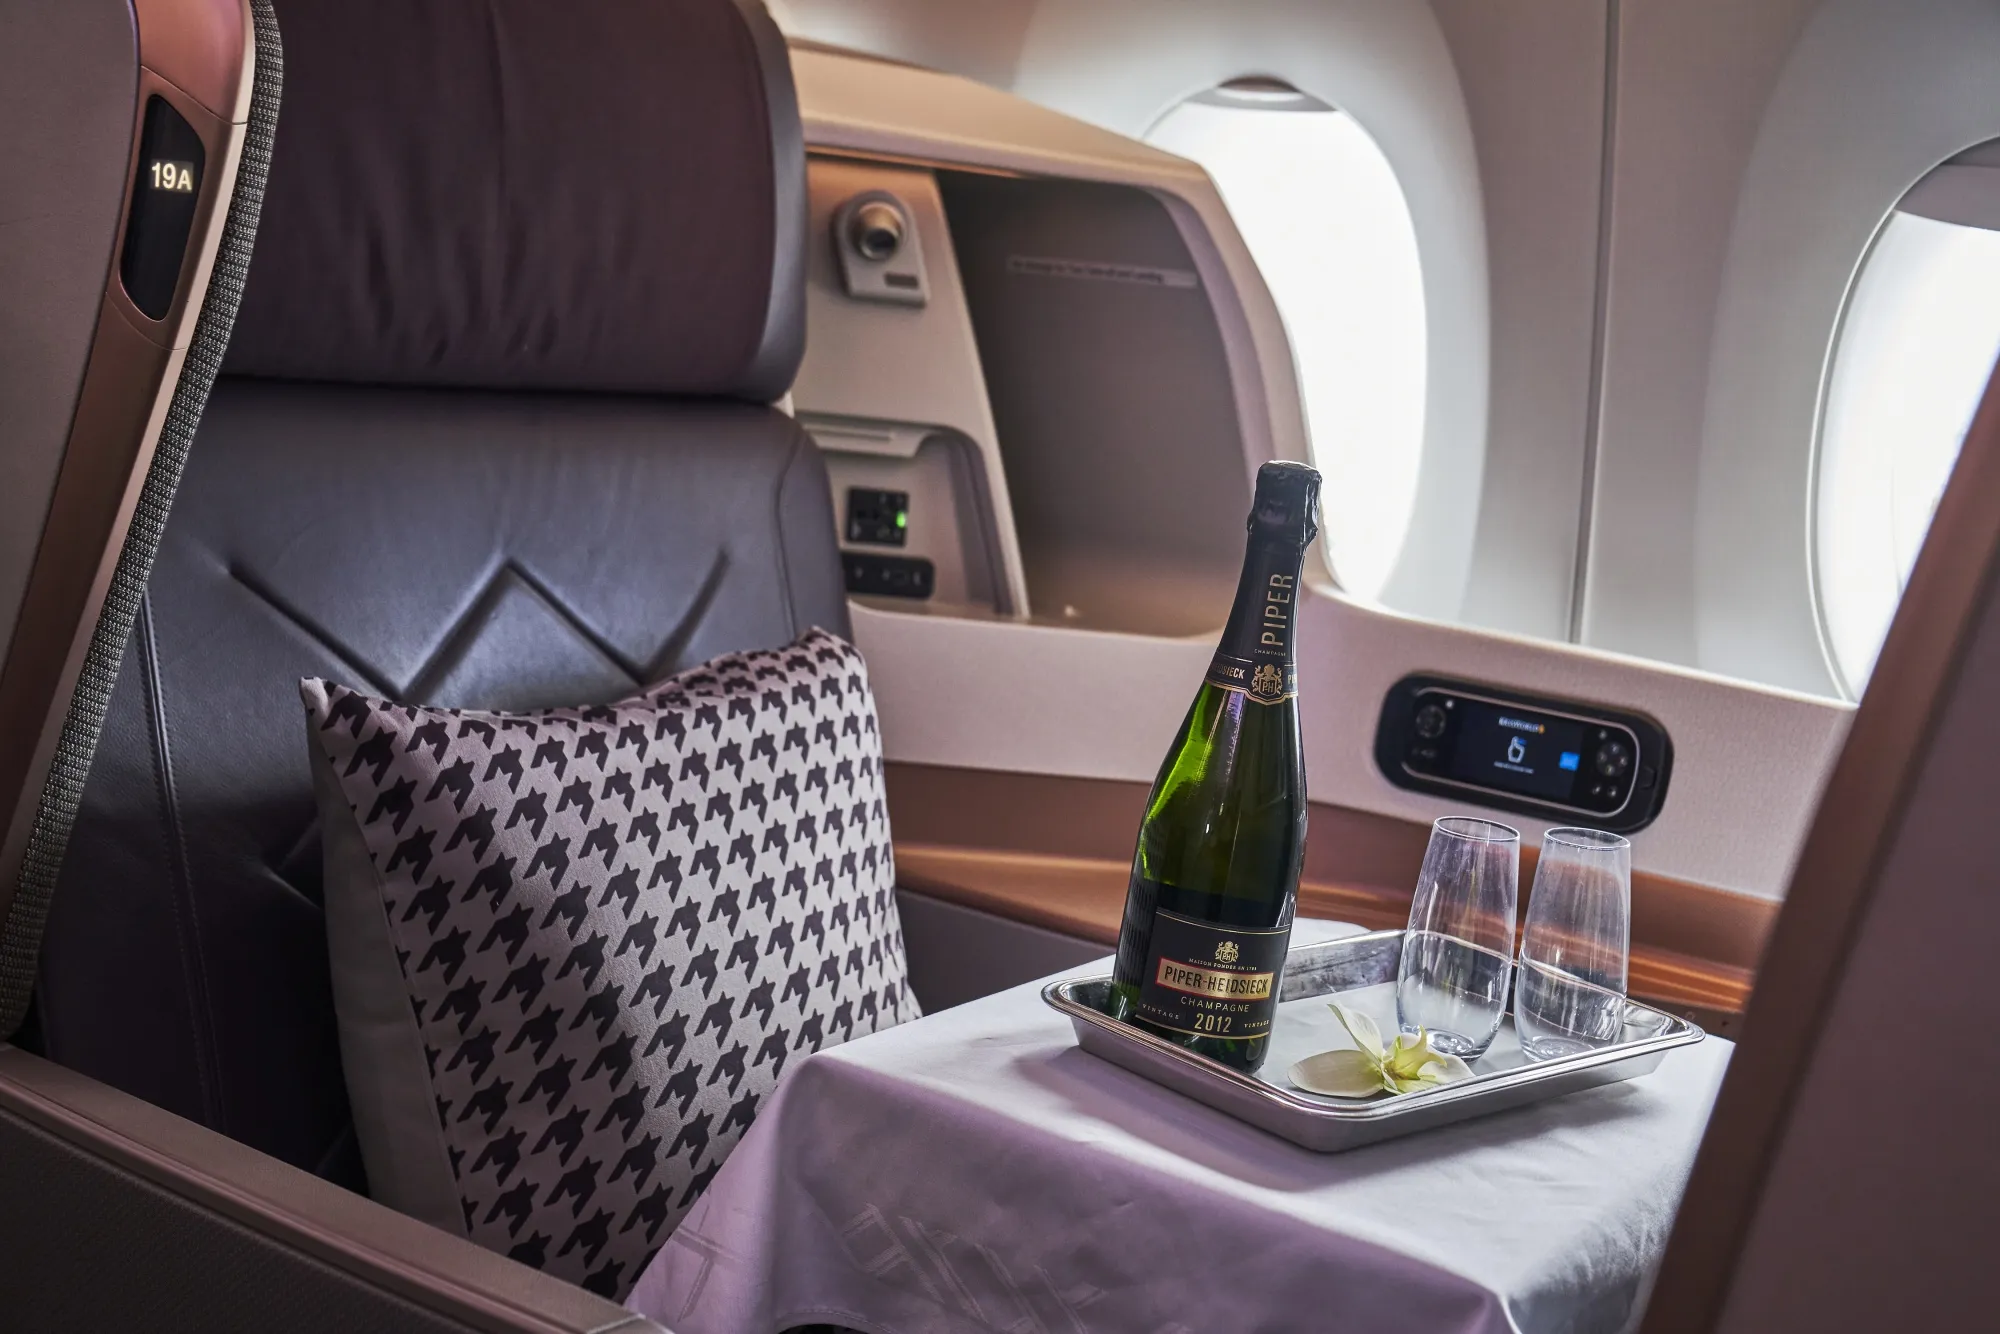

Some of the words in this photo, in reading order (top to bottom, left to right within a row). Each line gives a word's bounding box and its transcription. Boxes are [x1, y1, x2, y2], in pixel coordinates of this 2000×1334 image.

[152, 161, 192, 191] 19A
[1261, 574, 1293, 646] PIPER
[1189, 957, 1212, 967] MAISON
[1164, 965, 1269, 994] PIPER-HEIDSIECK
[1142, 1003, 1179, 1020] VINTAGE
[1194, 1013, 1232, 1033] 2012
[1244, 1019, 1270, 1029] VINTAGE
[1181, 996, 1250, 1013] CHAMPAGNE
